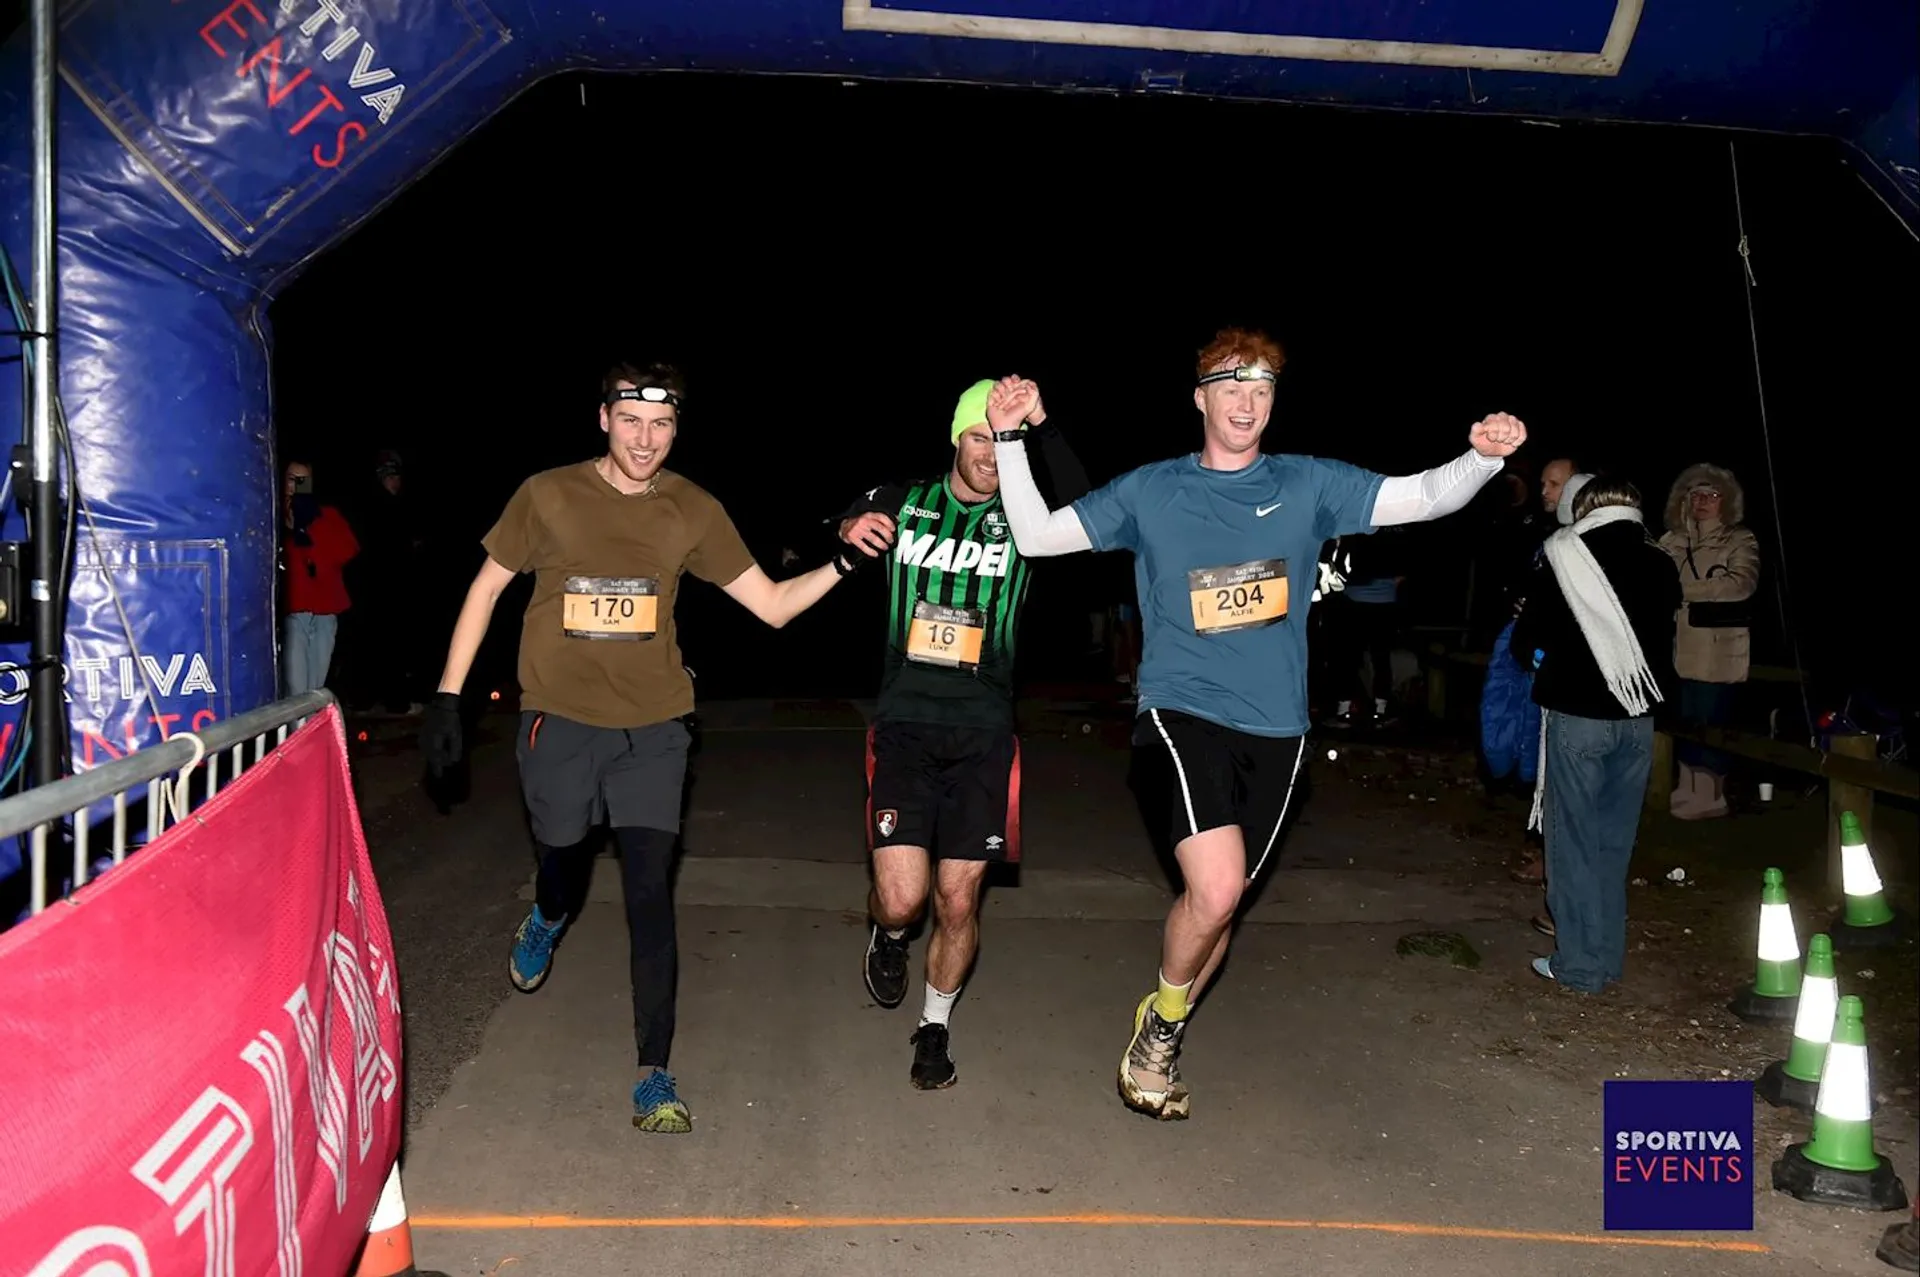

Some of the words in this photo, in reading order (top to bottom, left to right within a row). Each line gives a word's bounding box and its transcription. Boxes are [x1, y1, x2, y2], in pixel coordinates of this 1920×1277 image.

[278, 0, 405, 125] TIVA
[895, 529, 1012, 577] MAPEI
[590, 597, 634, 618] 170
[1216, 584, 1264, 611] 204
[1230, 608, 1254, 617] ALFIE
[928, 624, 956, 645] 16
